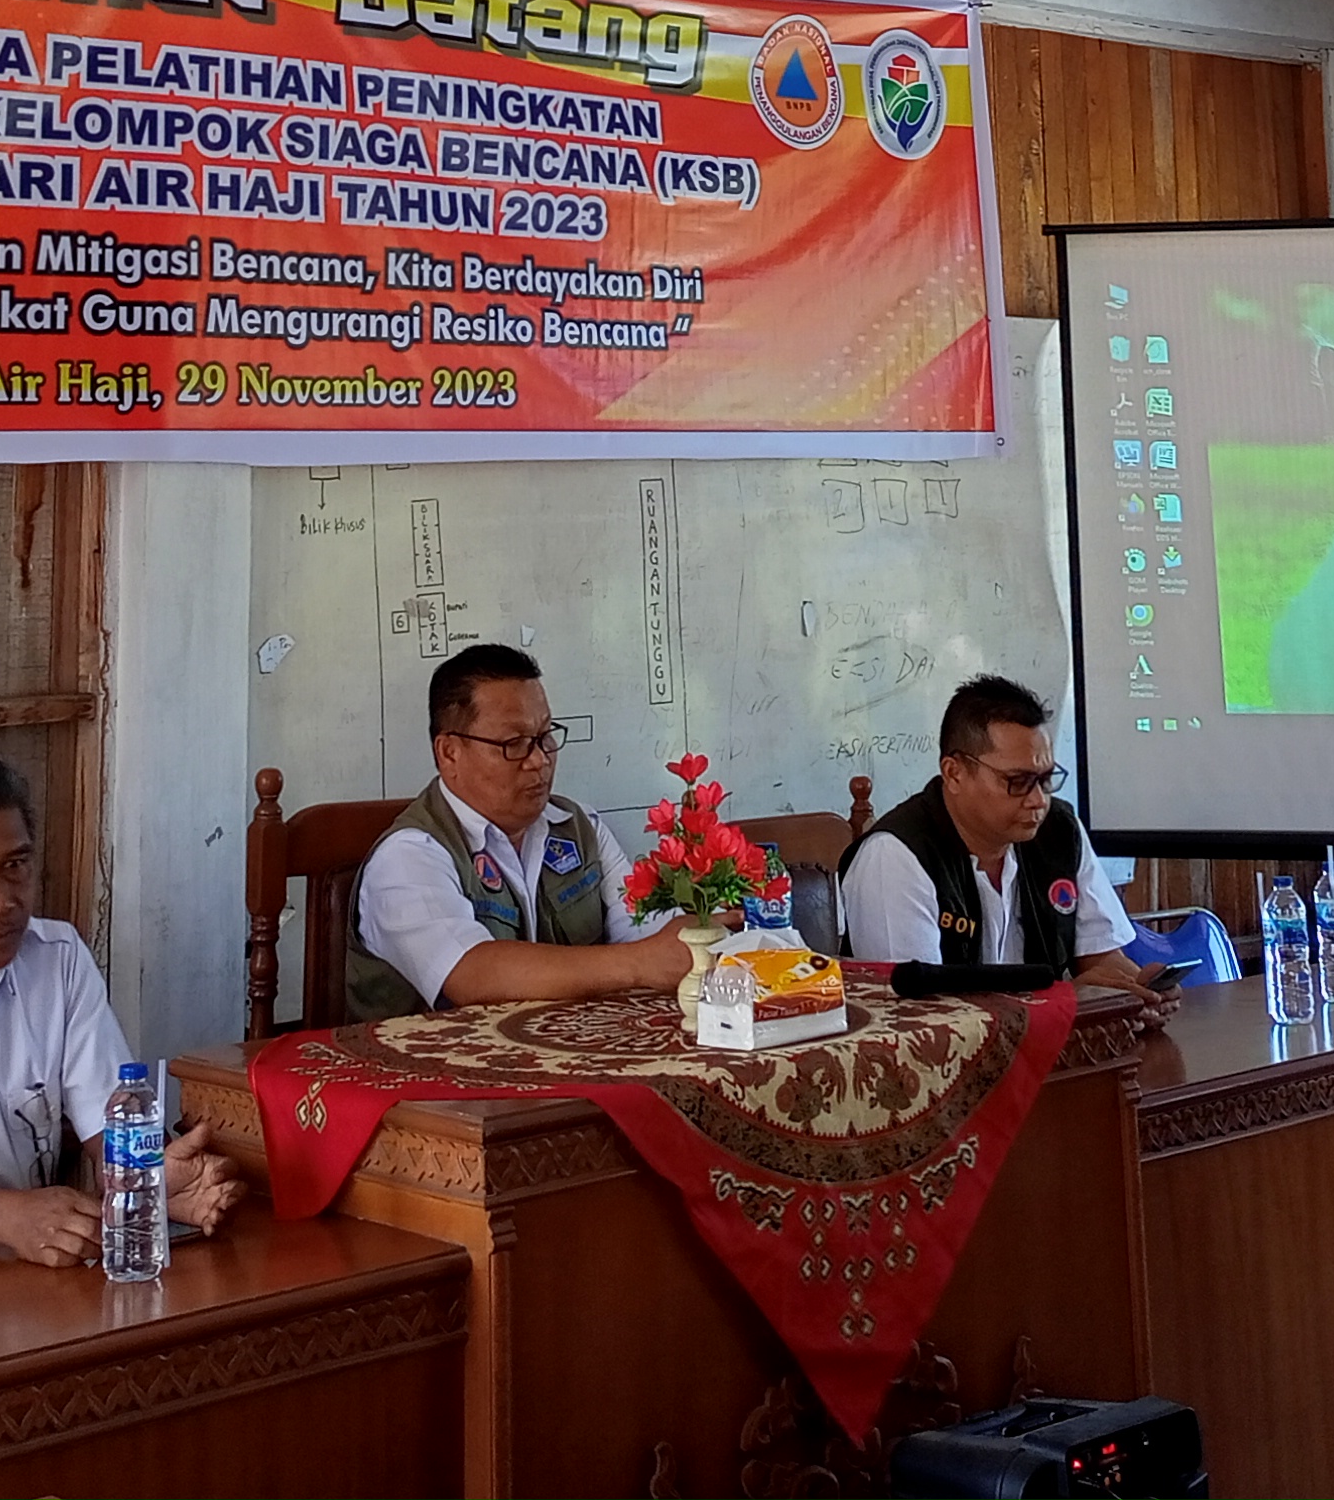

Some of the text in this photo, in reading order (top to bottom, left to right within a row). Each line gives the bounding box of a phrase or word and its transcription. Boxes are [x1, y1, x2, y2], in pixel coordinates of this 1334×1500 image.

[755, 23, 834, 76] BADAN NASIONAL
[48, 39, 344, 107] PELATIHAN
[355, 71, 661, 141] PENINGKATAN
[754, 76, 823, 141] PENANGGULANGAN
[821, 79, 839, 132] BENCANA
[284, 119, 428, 171] SIAGA
[440, 135, 649, 190] BENCANA
[656, 154, 759, 207] (KSB)
[92, 164, 193, 209] AIR
[206, 169, 321, 218] HAJI
[336, 180, 491, 231] TAHUN
[503, 195, 606, 238] 2023
[35, 233, 201, 285] Mitigasi
[211, 241, 379, 292] Bencana,
[386, 251, 453, 290] Kita
[463, 255, 645, 303] Berdayakan
[652, 267, 704, 302] Diri
[81, 293, 196, 333] Guna
[205, 297, 422, 348] Mengurangi
[432, 306, 534, 344] Resiko
[56, 361, 163, 413] Haji,
[177, 363, 227, 404] 29
[237, 364, 422, 407] November
[431, 368, 518, 407] 2023
[395, 615, 405, 628] 6
[646, 488, 667, 697] RUANGAN TUNGGU
